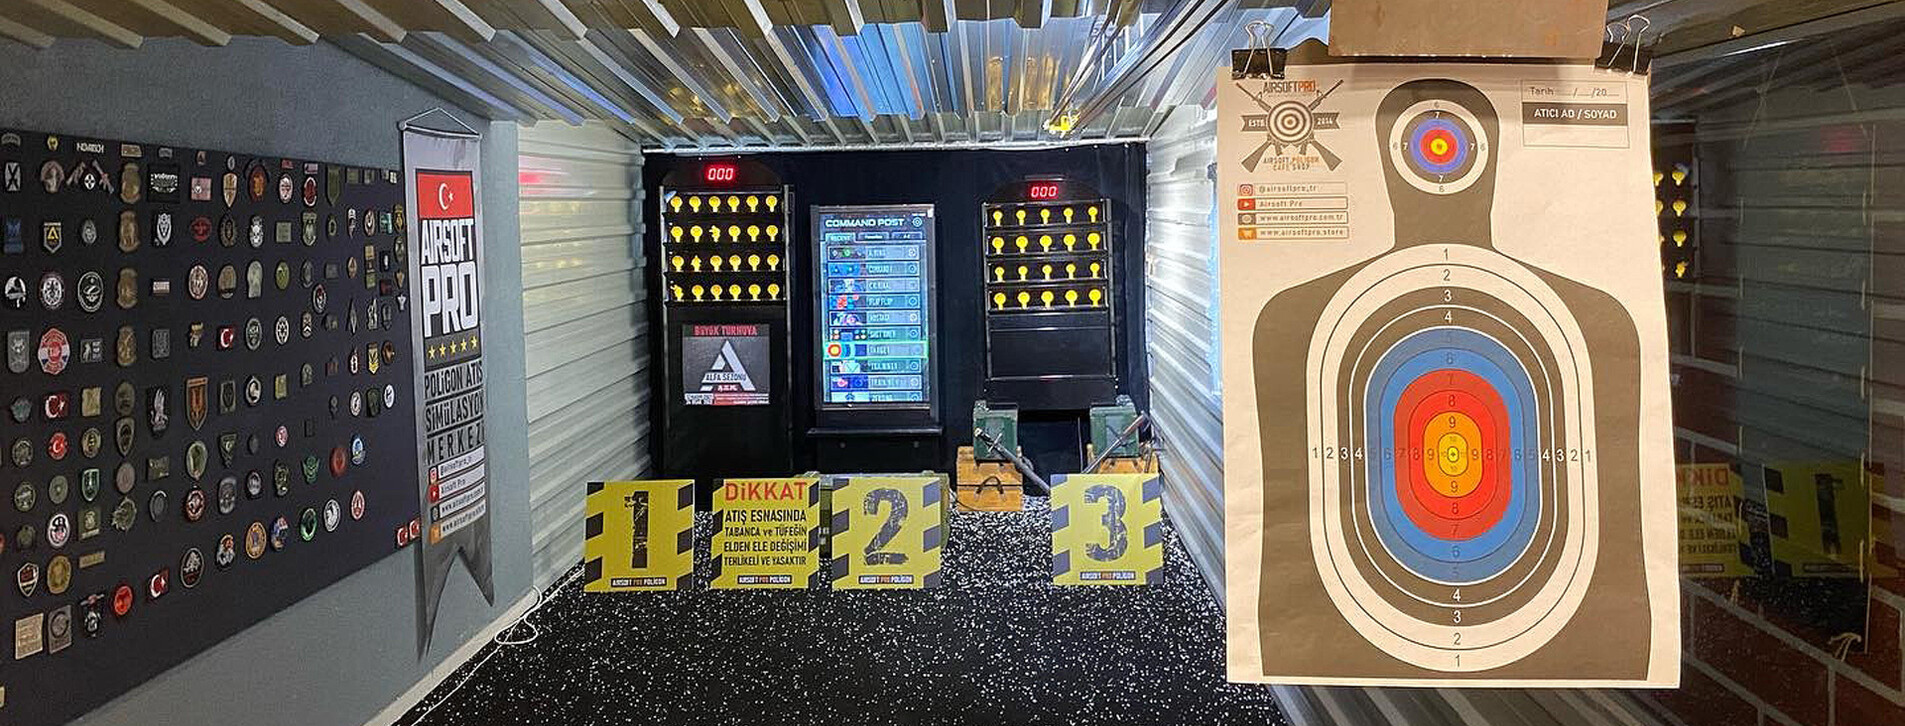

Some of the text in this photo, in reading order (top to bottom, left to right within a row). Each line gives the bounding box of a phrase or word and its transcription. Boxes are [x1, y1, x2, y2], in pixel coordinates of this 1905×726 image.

[1534, 109, 1617, 120] ATICI AD / SOYAD
[1403, 142, 1408, 150] 7
[1470, 142, 1475, 151] 7
[708, 167, 734, 180] 000
[1031, 186, 1057, 198] 000
[825, 218, 904, 228] COMMAND POST
[421, 218, 474, 264] AIRSOFT
[1444, 248, 1449, 260] 1
[1443, 269, 1450, 281] 2
[421, 261, 479, 338] PRO
[1444, 290, 1452, 302] 3
[1444, 311, 1452, 323] 4
[1449, 394, 1456, 407] 8
[1449, 416, 1456, 428] 9
[1312, 447, 1318, 458] 1
[1326, 447, 1334, 459] 2
[1340, 447, 1349, 460] 3
[1354, 447, 1363, 460] 4
[1413, 448, 1420, 460] 8
[1427, 448, 1434, 460] 9
[1472, 448, 1479, 460] 9
[1486, 449, 1493, 460] 8
[1542, 449, 1550, 461] 4
[1556, 449, 1565, 462] 3
[1570, 449, 1578, 461] 2
[1585, 450, 1591, 461] 1
[1451, 480, 1458, 492] 9
[1451, 503, 1459, 515] 8
[724, 509, 806, 525] ATIŞ ESNASINDA
[1084, 484, 1128, 562] 3
[624, 491, 649, 569] 1
[724, 527, 760, 537] TABANCA
[863, 489, 909, 566] 2
[724, 541, 750, 552] ELDEN
[752, 541, 768, 552] ELE
[1453, 547, 1460, 558] 6
[761, 556, 771, 566] VE
[772, 556, 806, 566] YASAKTIR
[1453, 589, 1461, 602] 4
[1453, 611, 1462, 624] 3
[1454, 633, 1461, 645] 2
[1455, 655, 1461, 667] 1
